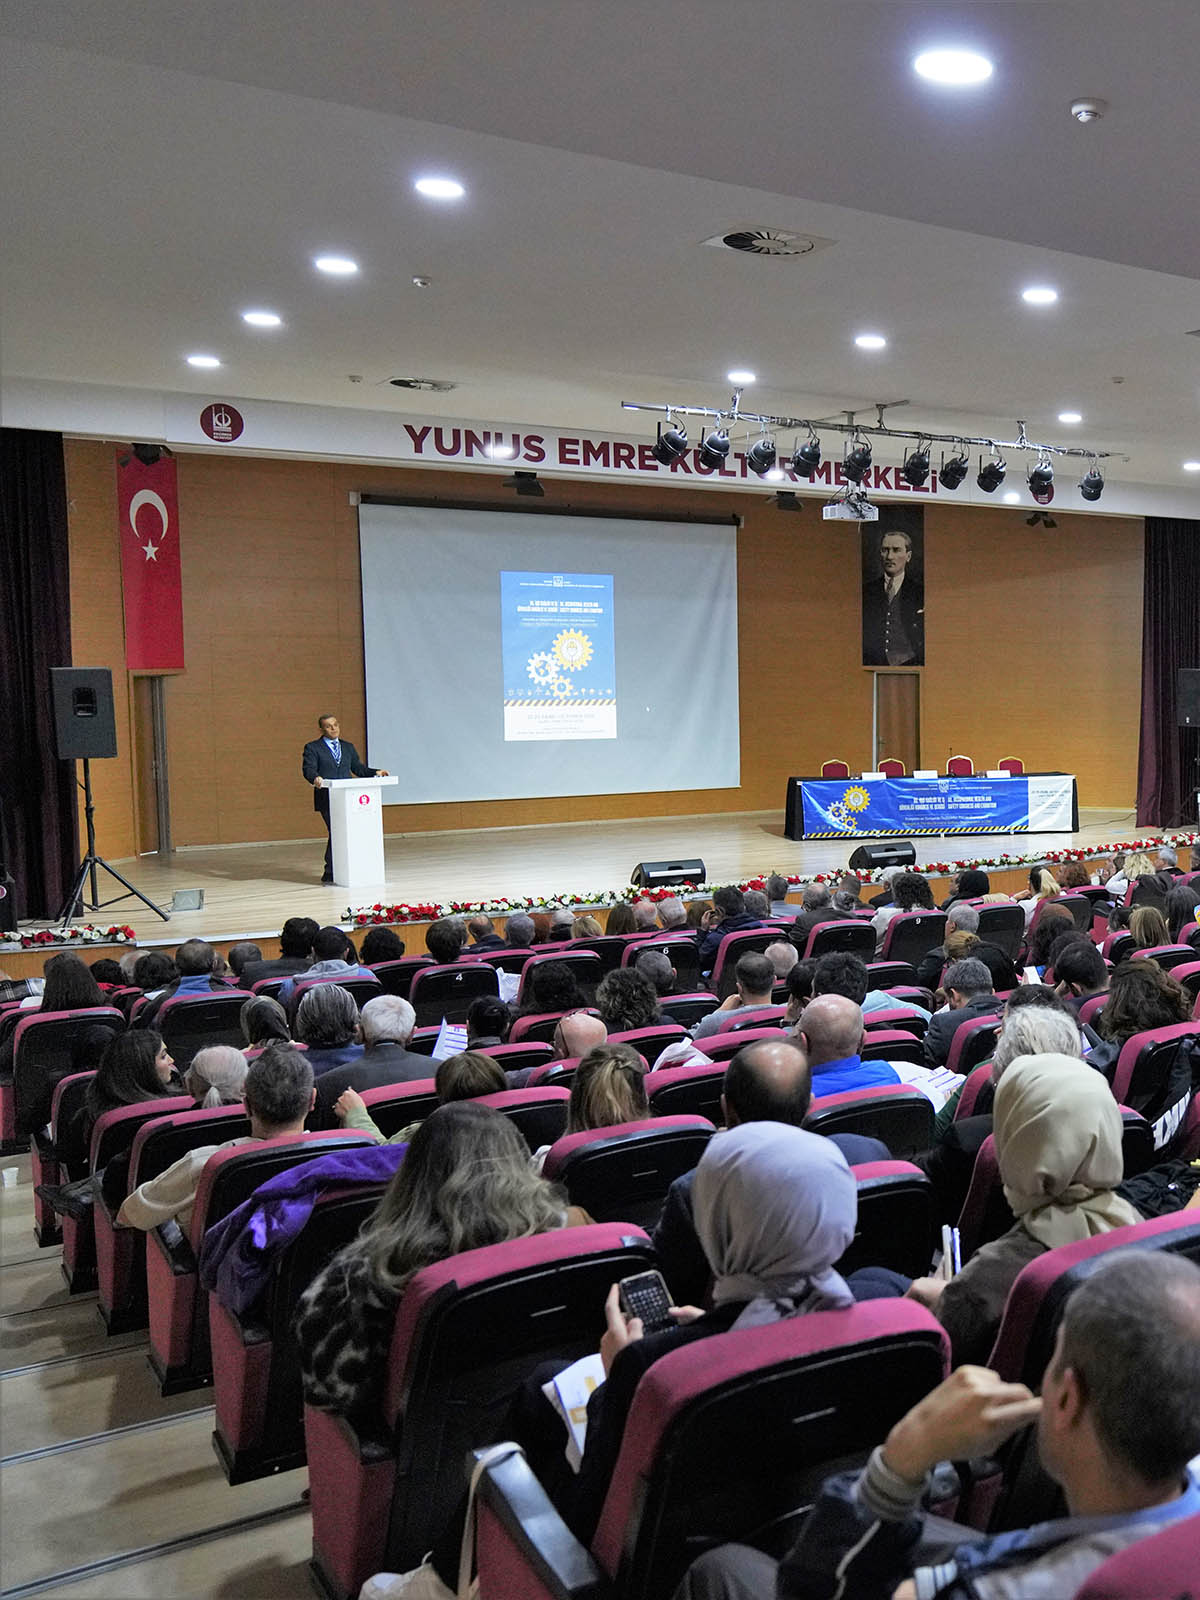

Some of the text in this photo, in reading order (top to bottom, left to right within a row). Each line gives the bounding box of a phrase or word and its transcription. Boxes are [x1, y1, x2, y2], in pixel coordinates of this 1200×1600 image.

[403, 424, 546, 463] YUNUS
[558, 437, 659, 471] EMRE
[669, 443, 799, 482] KÜLTR
[916, 917, 921, 925] 9
[663, 946, 669, 954] 6
[456, 973, 463, 981] 4
